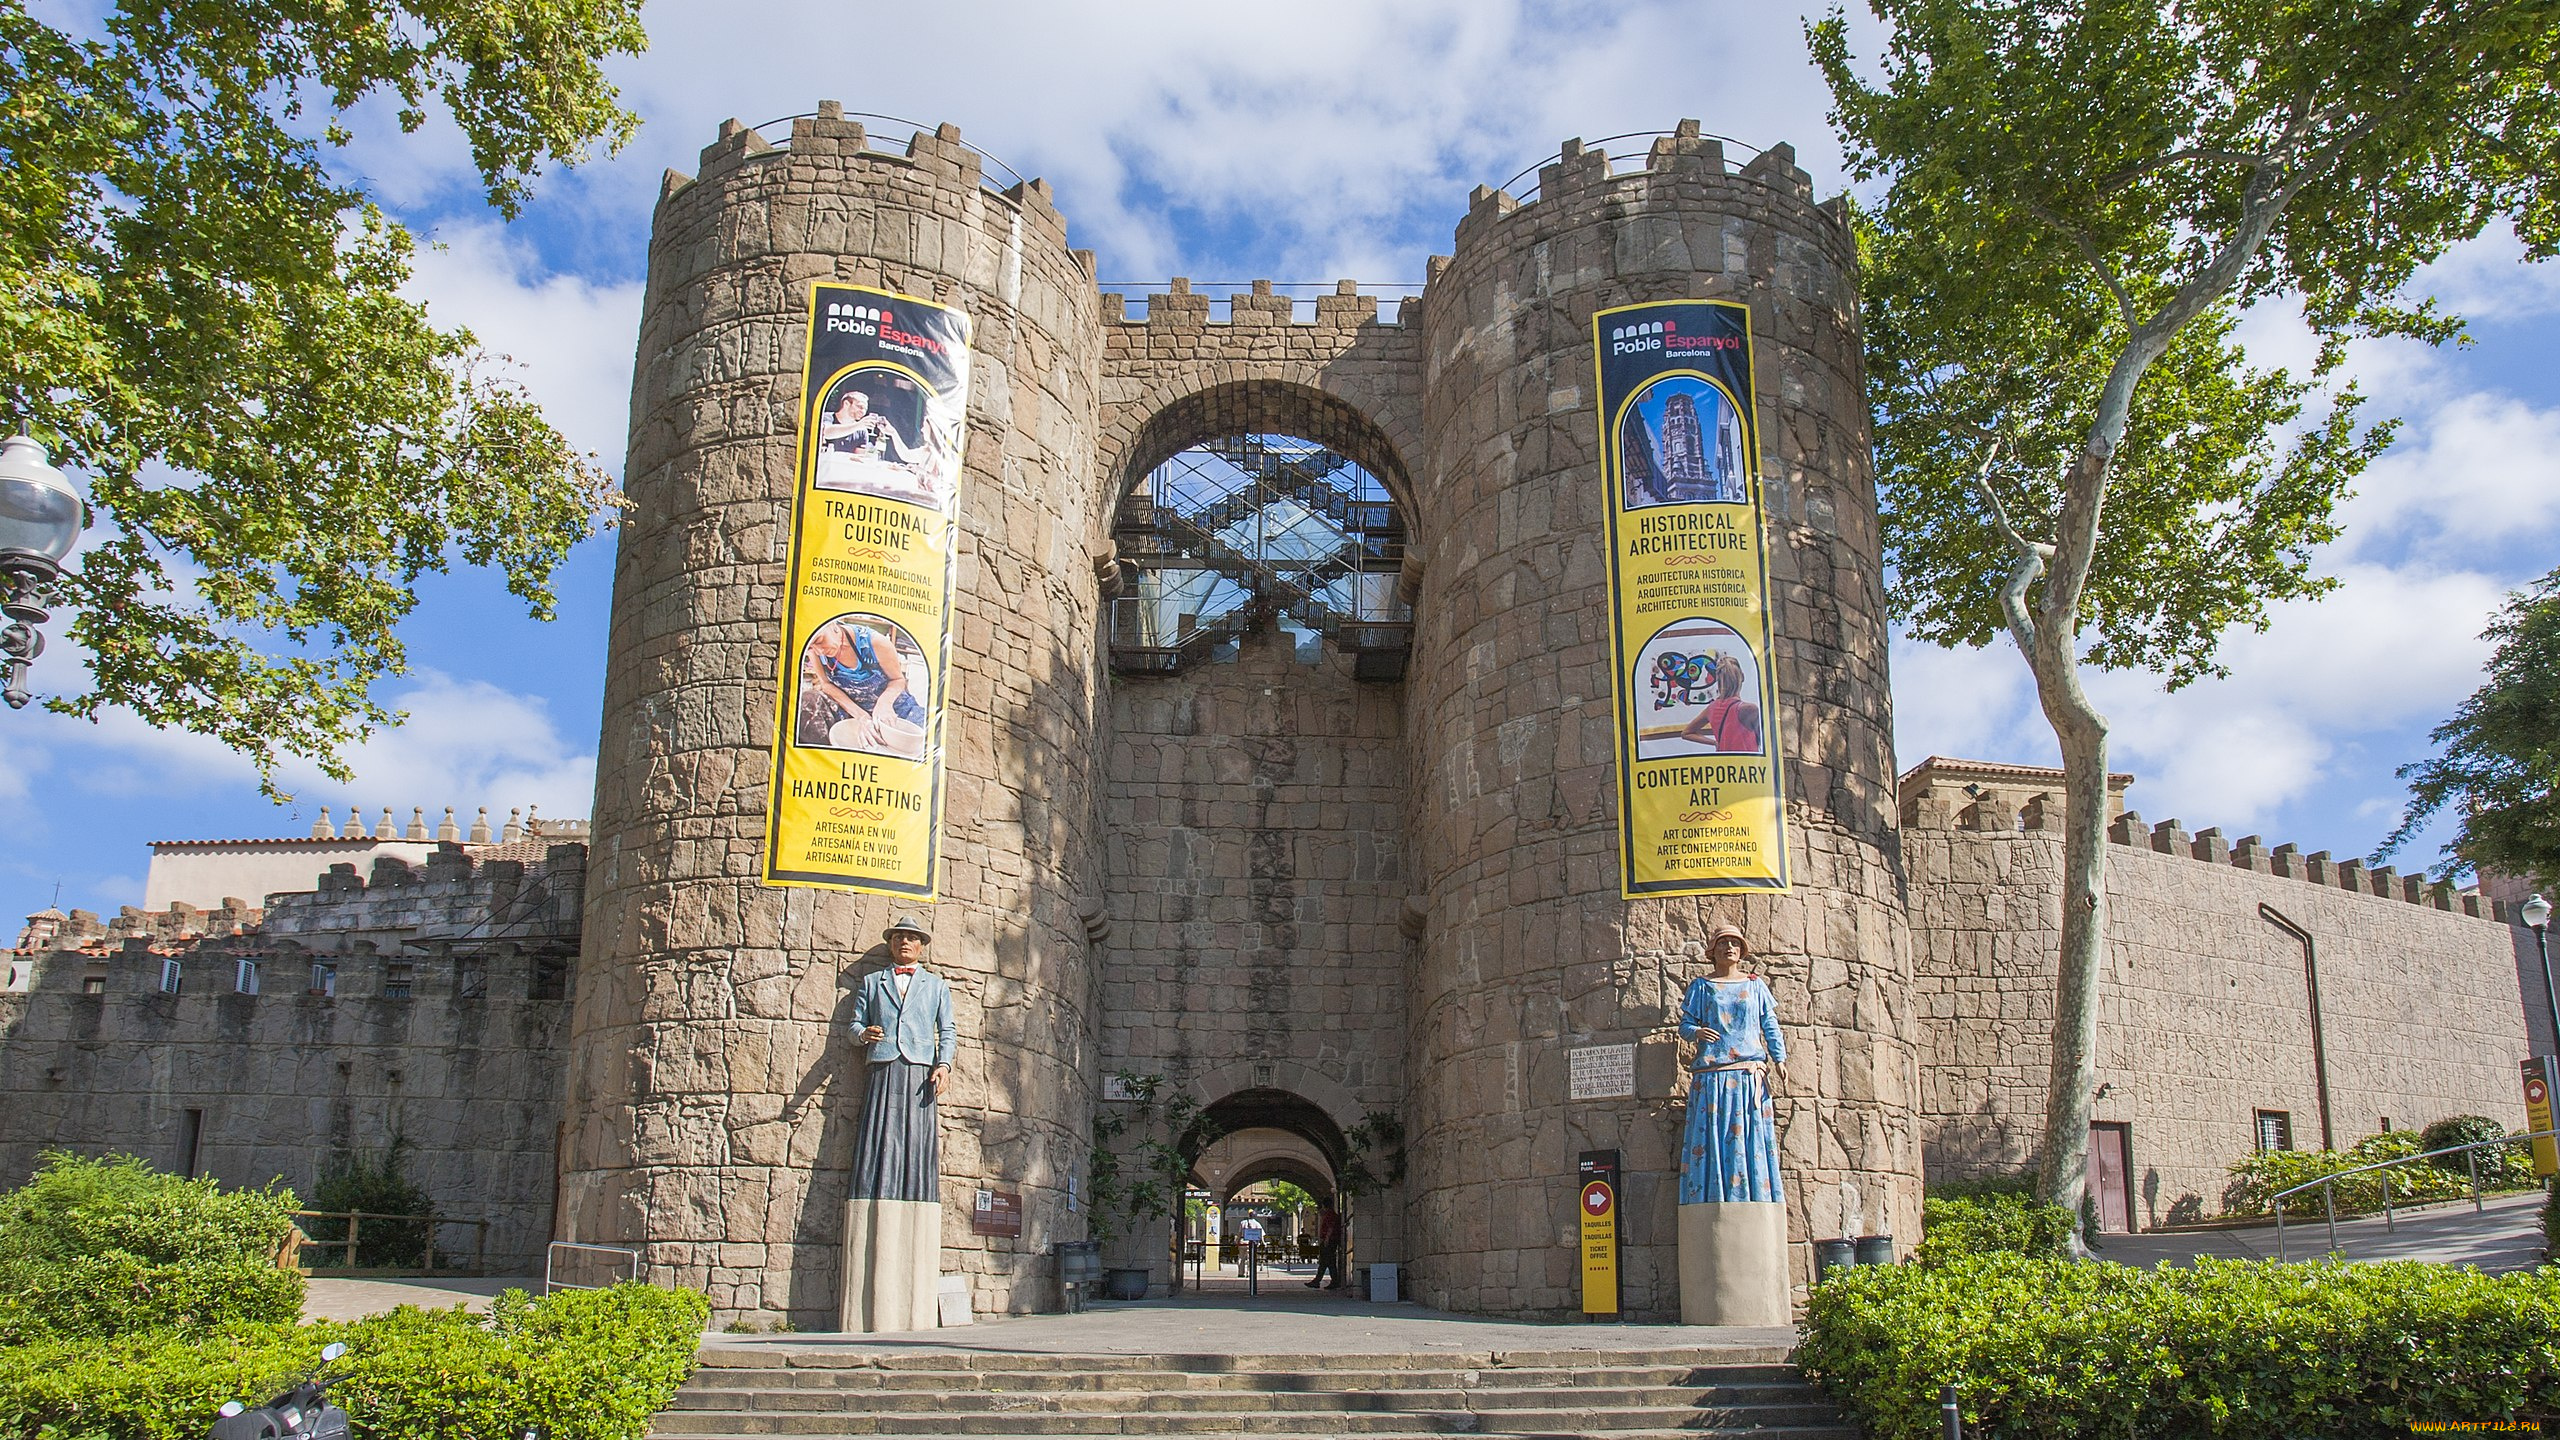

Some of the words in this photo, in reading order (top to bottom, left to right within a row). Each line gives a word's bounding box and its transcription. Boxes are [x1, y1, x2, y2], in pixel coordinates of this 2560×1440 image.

[827, 318, 876, 336] Poble
[878, 340, 924, 358] Barcelona
[1613, 337, 1661, 356] Poble
[1665, 334, 1740, 350] Espanyol
[1666, 350, 1711, 358] Barcelona
[825, 500, 931, 535] TRADITIONAL
[1640, 513, 1734, 535] HISTORICAL
[844, 523, 911, 551] CUISINE
[1629, 533, 1748, 557] ARCHITECTURE
[812, 557, 875, 575] GASTRONOMIA
[878, 565, 933, 587] TRADICIONAL
[1636, 570, 1700, 585] ARQUITECTURA
[811, 571, 874, 590] GASTRONOMÍA
[876, 580, 931, 601] TRADICIONAL
[1637, 585, 1701, 600] ARQUITECTURA
[802, 585, 865, 602] GASTRONOMIE
[868, 593, 938, 617] TRADITIONNELLE
[1636, 599, 1699, 614] ARCHITECTURE
[1701, 597, 1749, 609] HISTORIQUE
[841, 761, 879, 783] LIVE
[1637, 765, 1767, 789] CONTEMPORARY
[792, 779, 922, 812] HANDCRAFTING
[1689, 787, 1720, 807] ART
[815, 821, 864, 836] ARTESANIA
[867, 826, 879, 837] EN
[882, 829, 896, 840] VIU
[1663, 829, 1680, 840] ART
[1681, 826, 1750, 839] CONTEMPORANI
[811, 837, 860, 851] ARTESANÍA
[863, 842, 875, 853] EN
[877, 843, 898, 856] VIVO
[1657, 844, 1679, 857] ARTE
[1681, 840, 1757, 854] CONTEMPORÁNEO
[805, 851, 853, 865] ARTISANAT
[856, 856, 868, 867] EN
[871, 857, 901, 871] DIRECT
[1664, 859, 1681, 871] ART
[1683, 856, 1752, 869] CONTEMPORAIN
[1584, 1220, 1611, 1228] TAQUILLES
